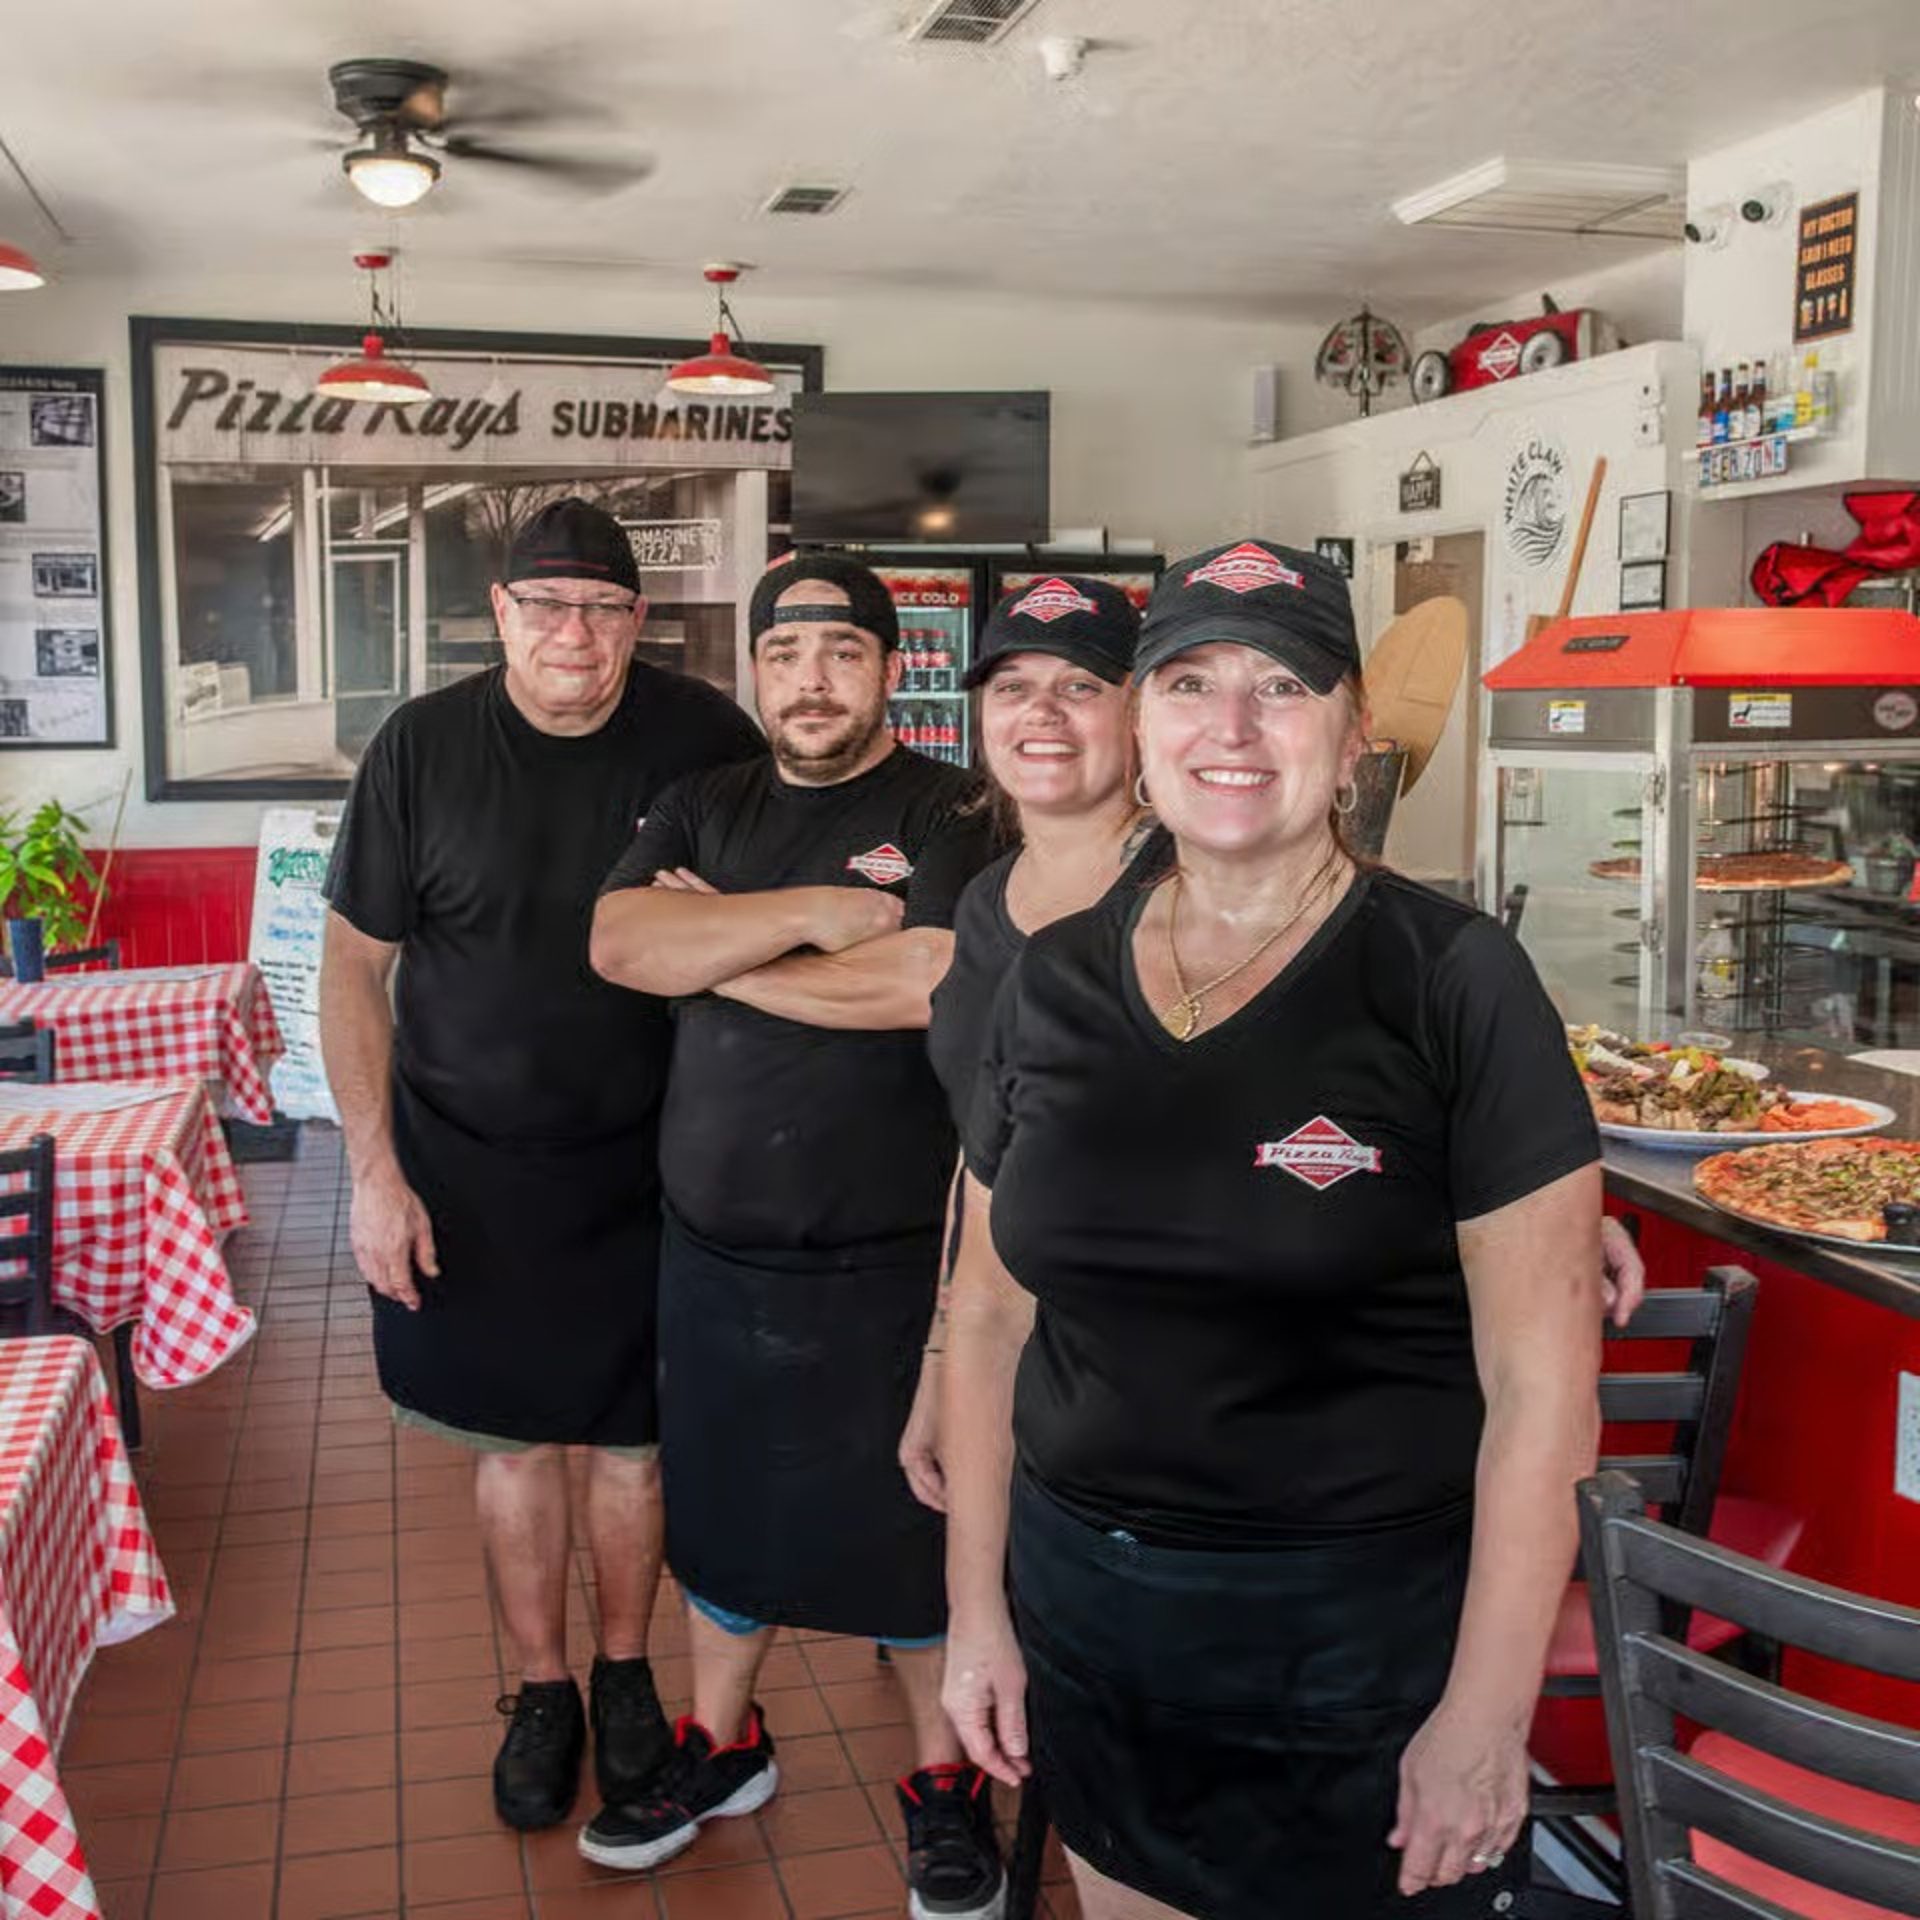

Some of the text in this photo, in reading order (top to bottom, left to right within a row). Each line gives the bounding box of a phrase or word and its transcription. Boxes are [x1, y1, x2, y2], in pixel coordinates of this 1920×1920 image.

[166, 368, 356, 434] Pizza
[551, 400, 794, 442] SUBMARINES
[921, 591, 960, 605] COLD
